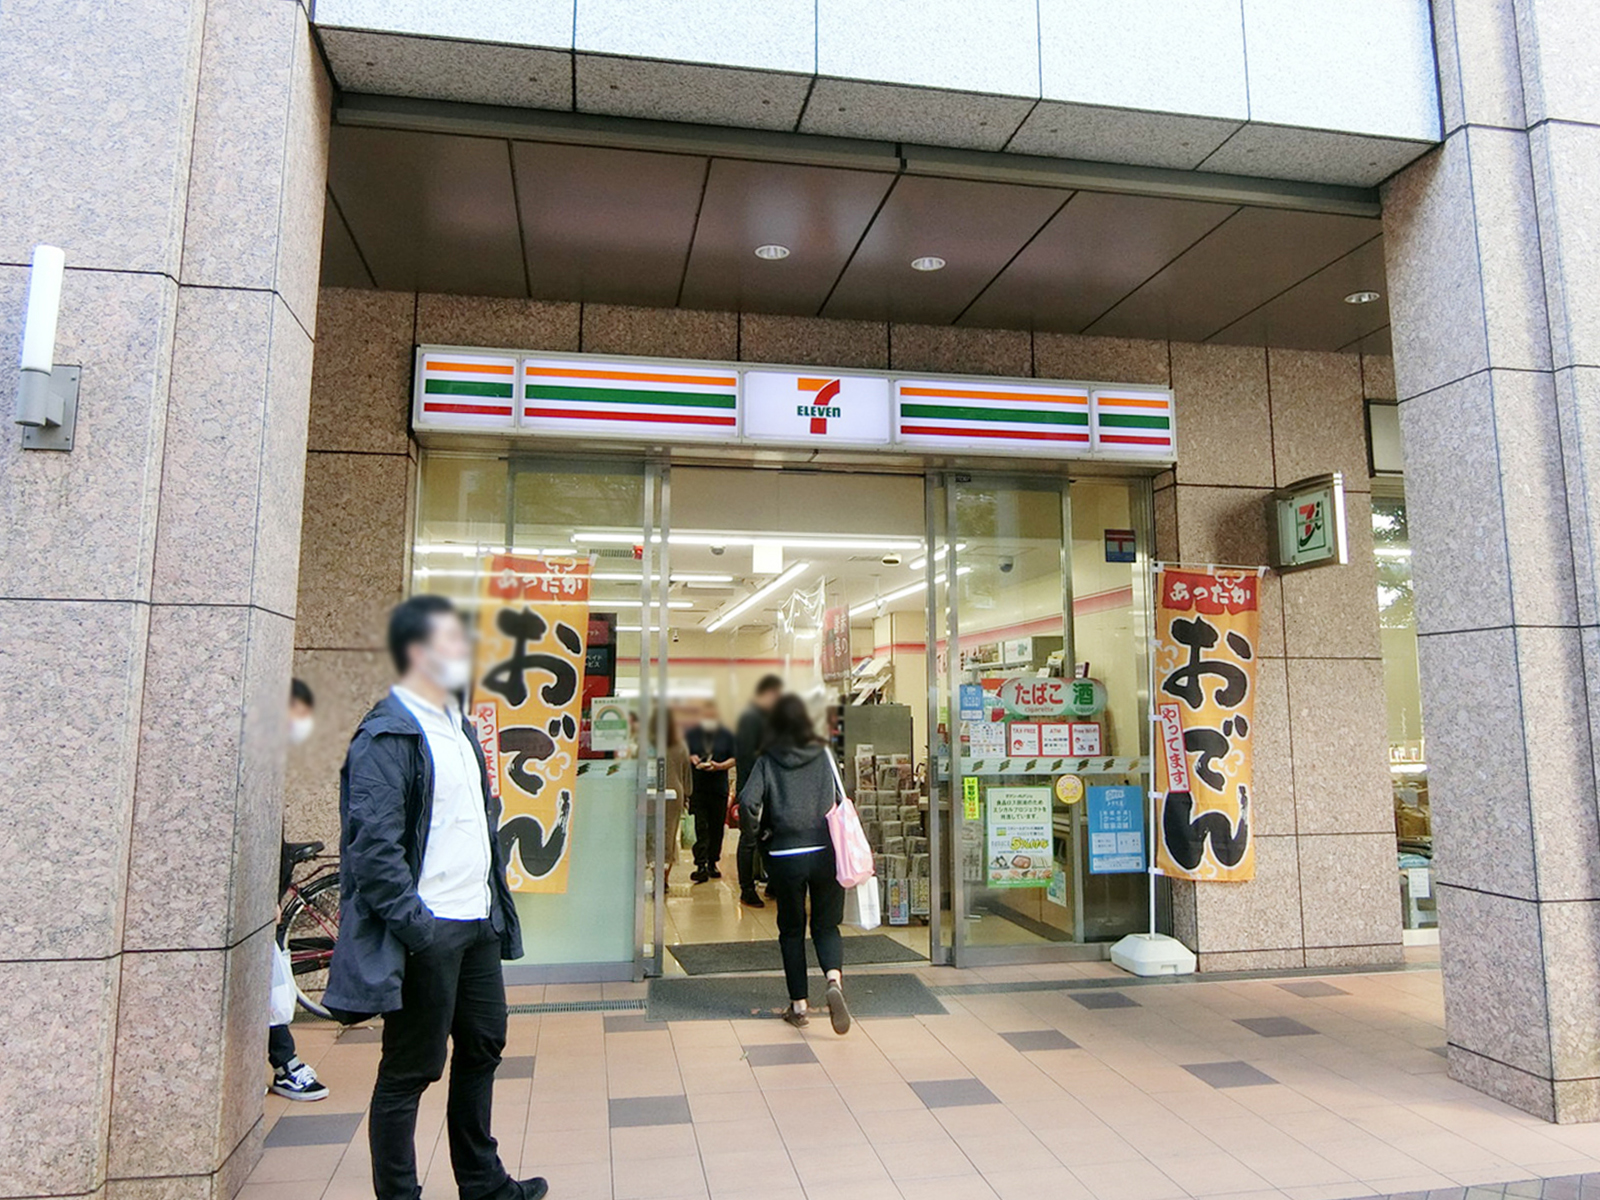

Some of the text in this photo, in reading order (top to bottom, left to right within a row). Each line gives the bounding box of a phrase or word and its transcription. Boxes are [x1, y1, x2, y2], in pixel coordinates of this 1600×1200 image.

[497, 567, 583, 595] あったか
[1169, 581, 1251, 605] あったか
[1014, 682, 1094, 706] たばこ 酒
[481, 606, 582, 878] おでん
[1162, 614, 1252, 870] おでん
[1162, 707, 1189, 790] やってます。
